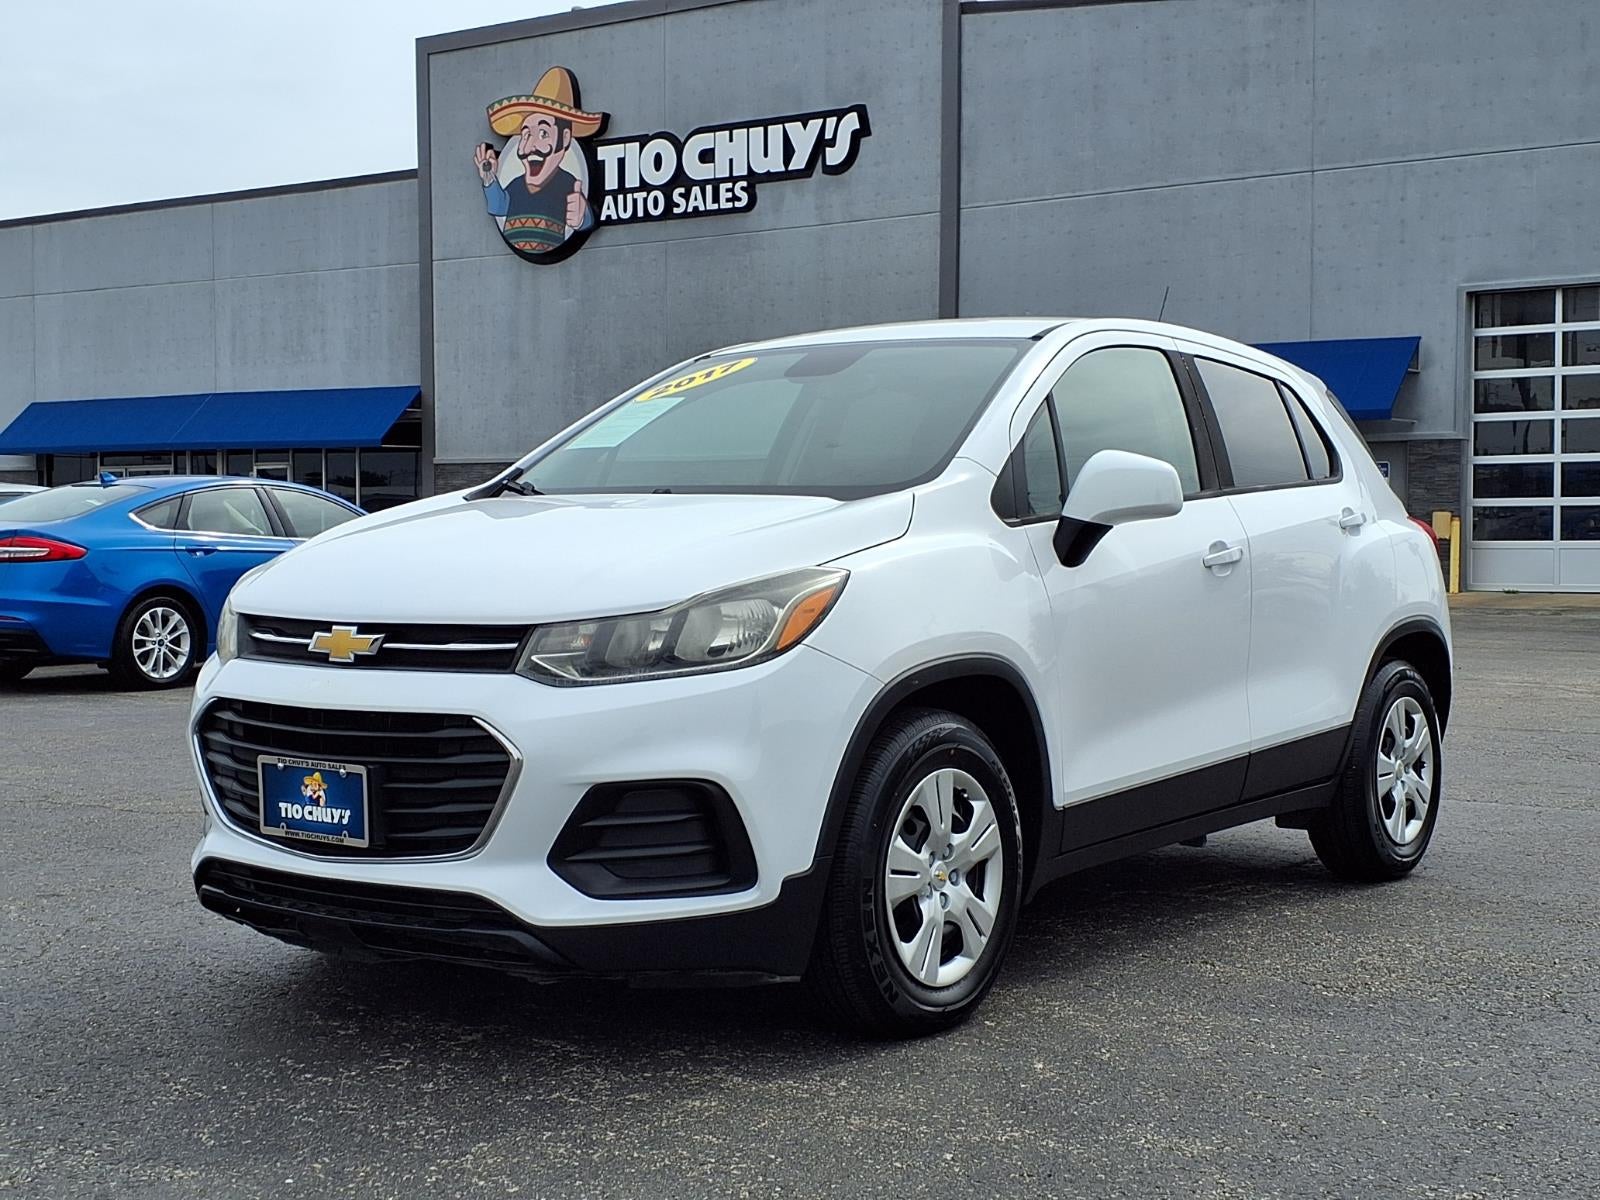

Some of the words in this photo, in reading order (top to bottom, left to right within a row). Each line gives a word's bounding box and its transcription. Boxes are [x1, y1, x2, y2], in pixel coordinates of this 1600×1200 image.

[597, 138, 677, 190] TIO
[682, 112, 860, 179] CHUY'S
[600, 191, 665, 221] AUTO
[673, 181, 749, 214] SALES
[647, 360, 743, 399] 2017
[279, 803, 302, 819] TIO
[303, 806, 350, 824] CHUY'S
[285, 830, 344, 843] WWW.TIOCHUYS.COM
